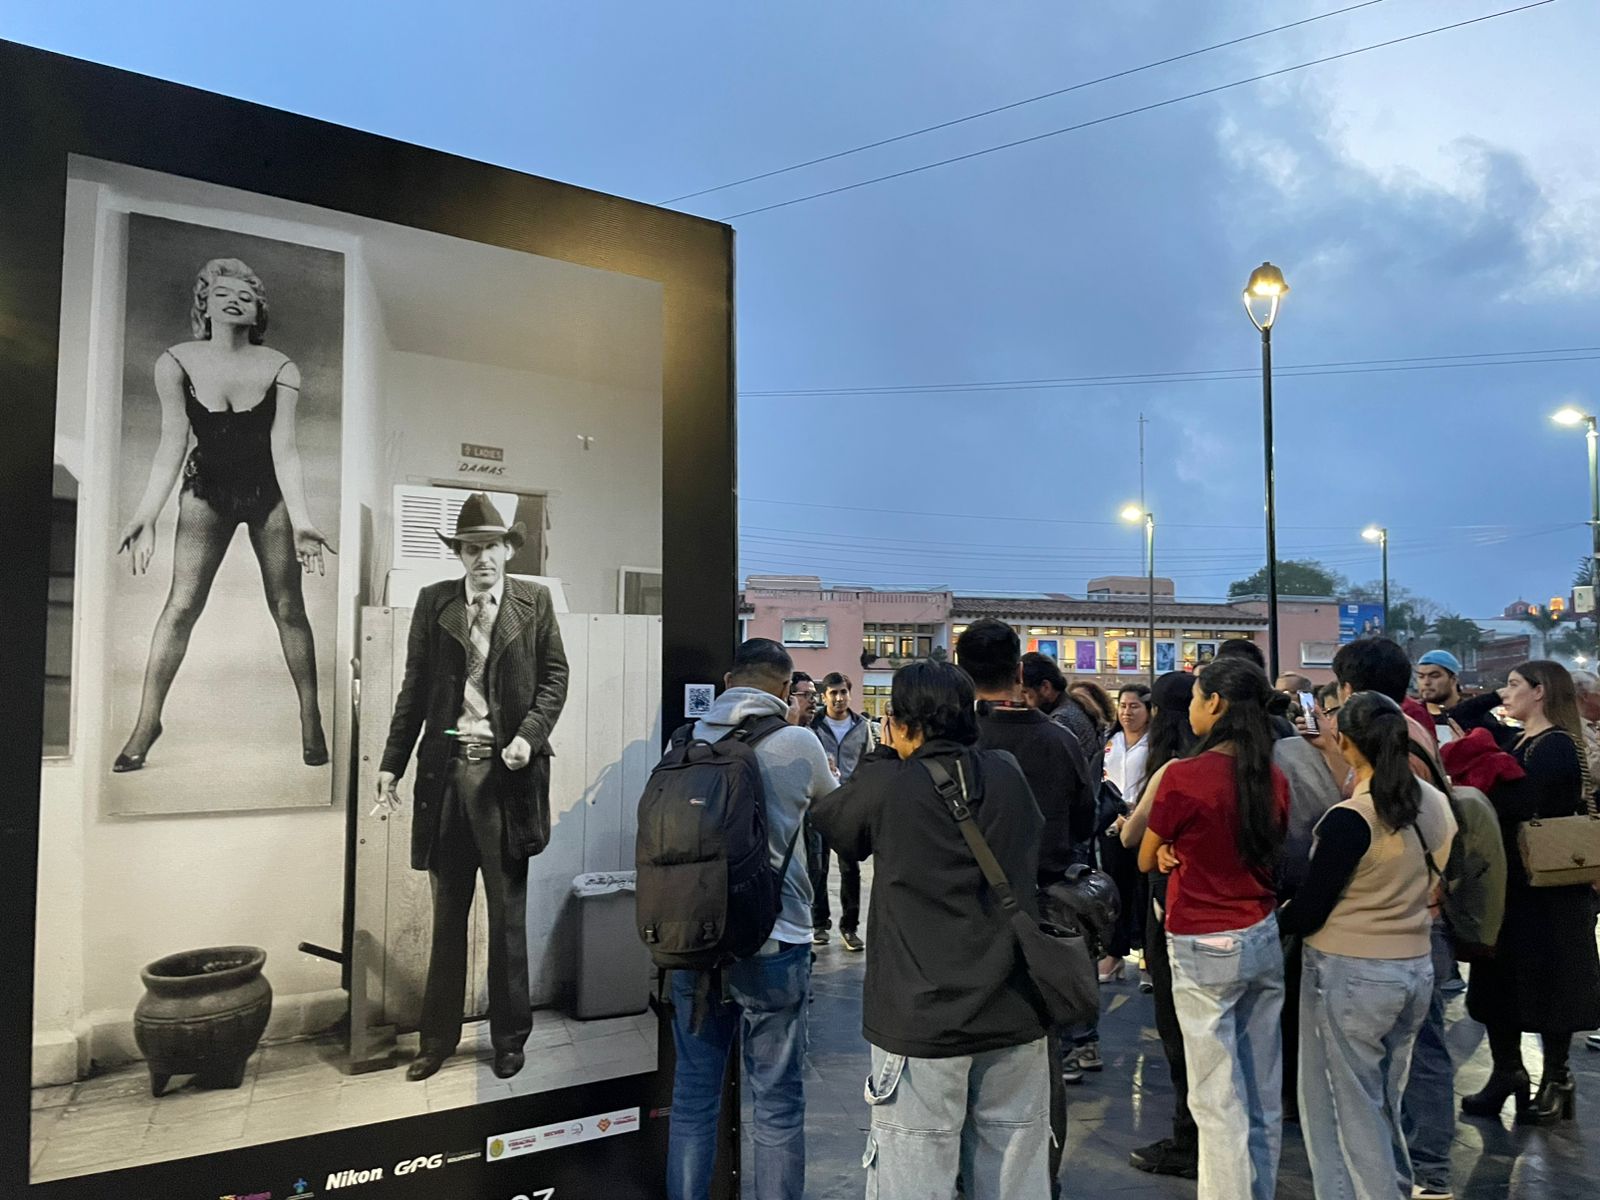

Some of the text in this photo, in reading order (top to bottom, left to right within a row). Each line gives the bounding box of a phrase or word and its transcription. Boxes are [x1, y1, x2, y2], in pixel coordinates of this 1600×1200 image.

[459, 463, 505, 475] DAMAS
[394, 1153, 443, 1176] GPG
[325, 1167, 383, 1190] Nikon
